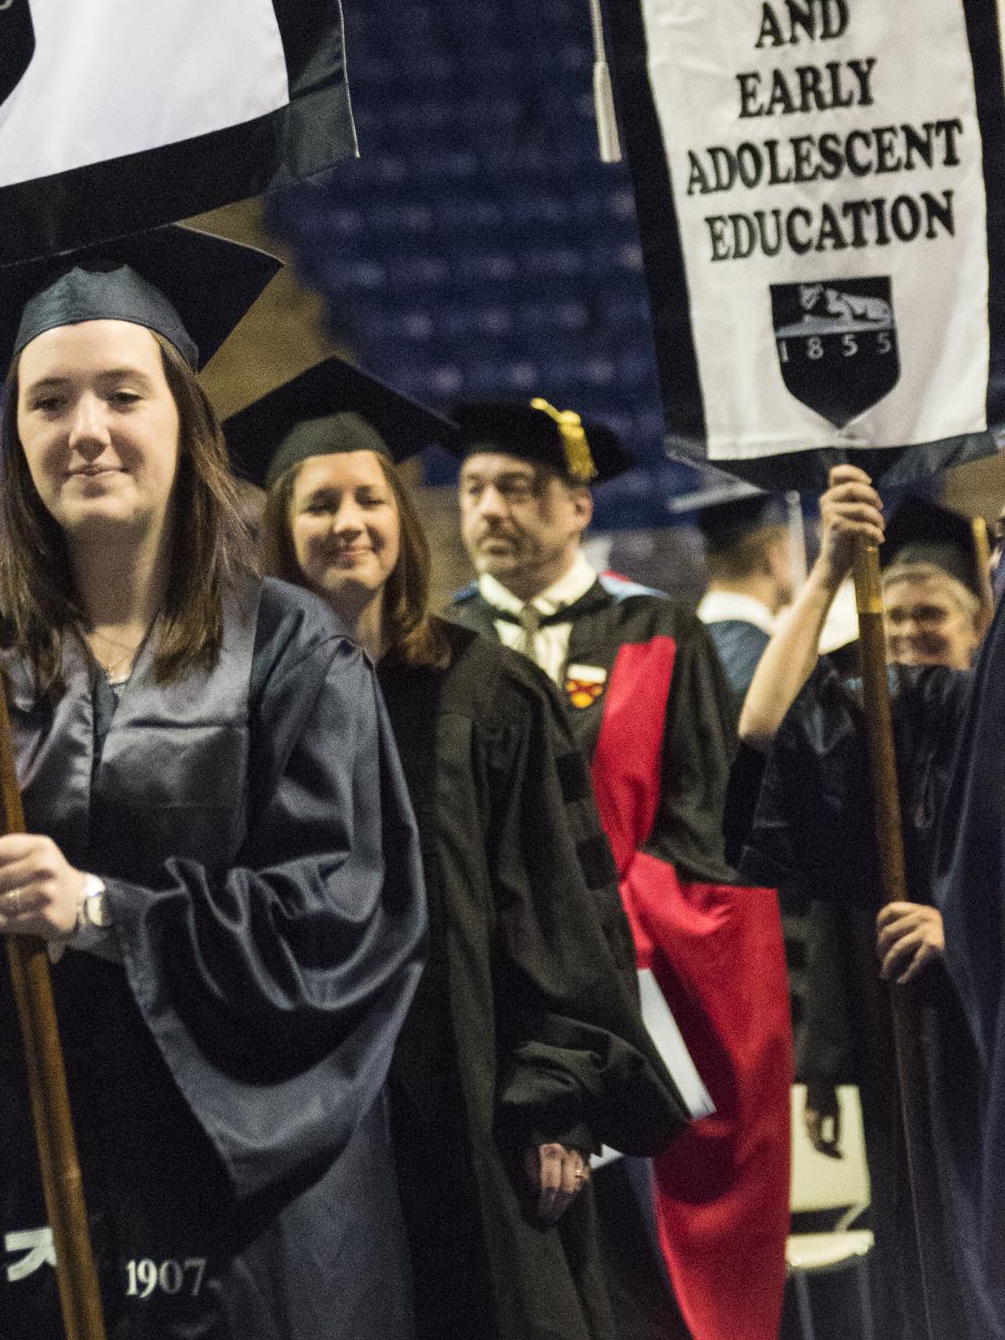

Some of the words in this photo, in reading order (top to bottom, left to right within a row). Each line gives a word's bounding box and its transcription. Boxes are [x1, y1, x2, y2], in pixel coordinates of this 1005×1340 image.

[736, 58, 878, 119] EARLY
[686, 119, 963, 196] ADOLESCENT
[705, 190, 956, 261] EDUCATION
[125, 1257, 207, 1299] 1907
